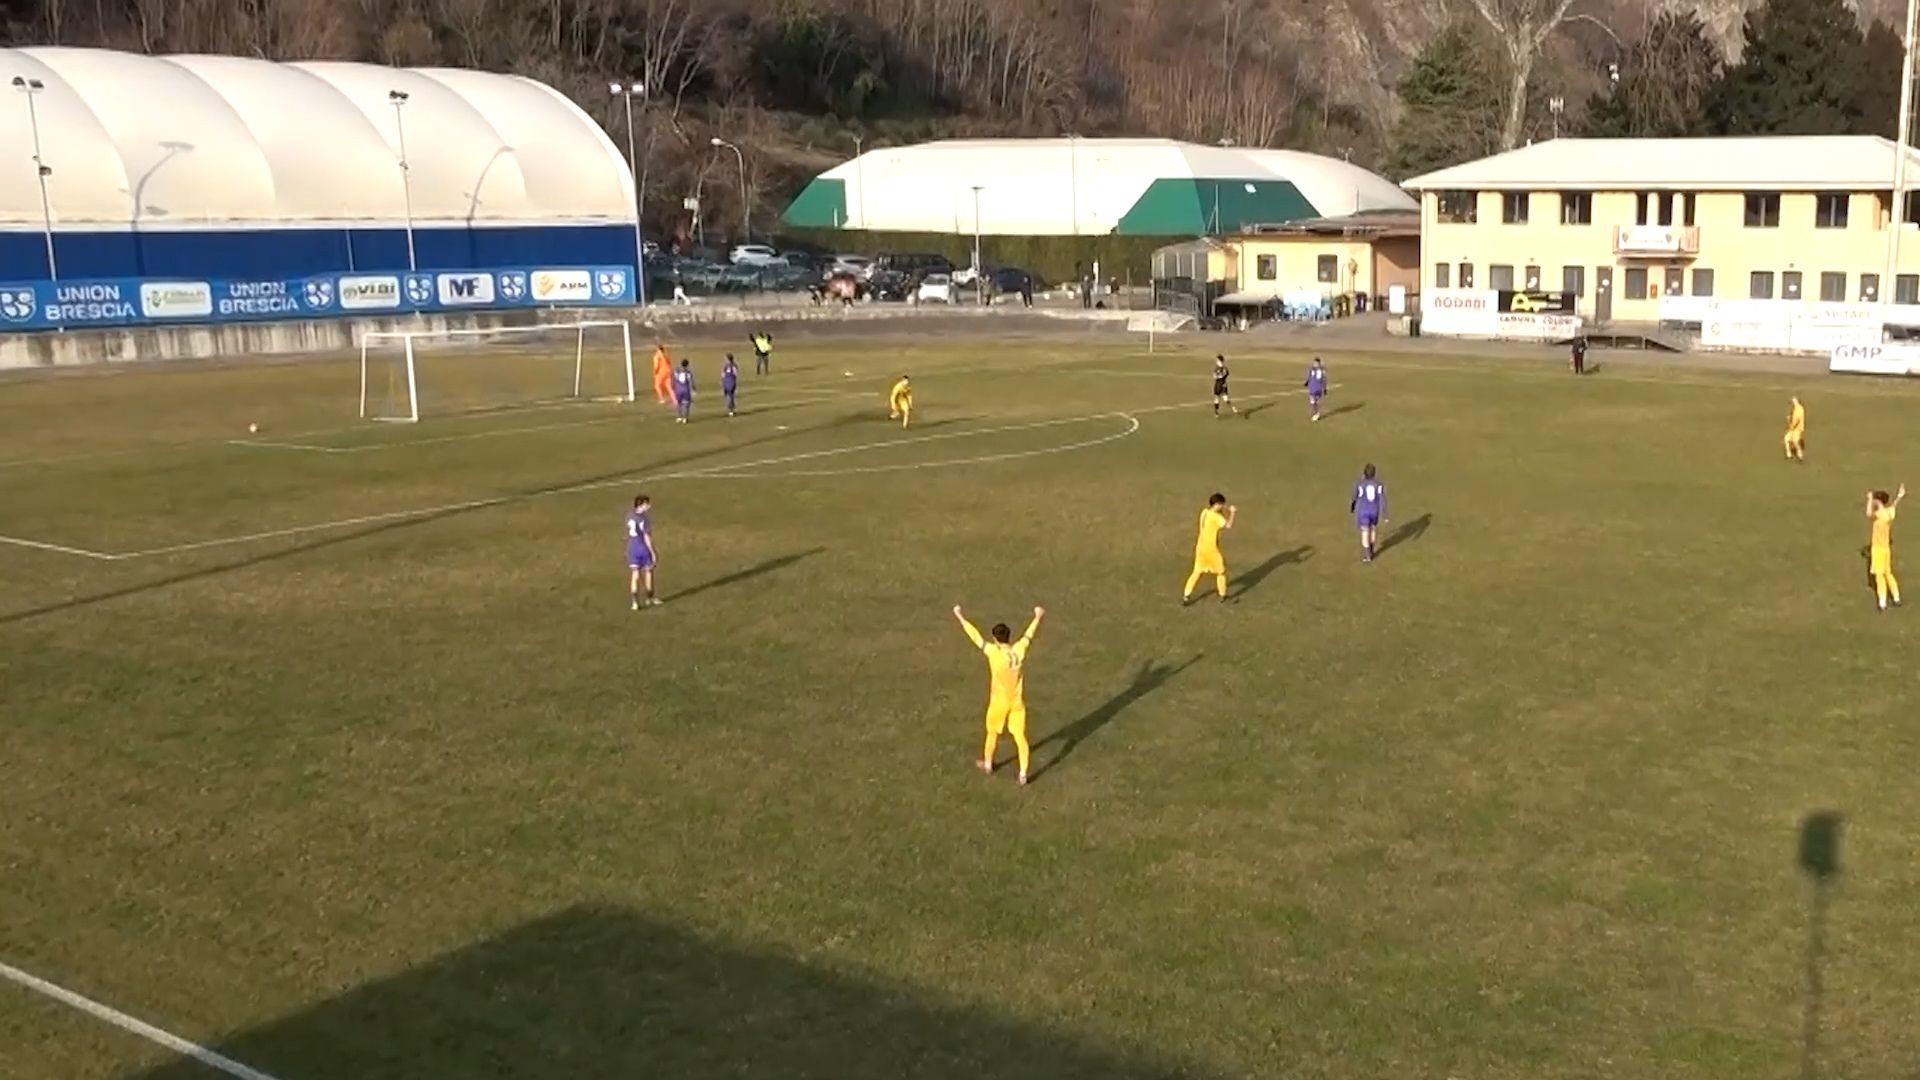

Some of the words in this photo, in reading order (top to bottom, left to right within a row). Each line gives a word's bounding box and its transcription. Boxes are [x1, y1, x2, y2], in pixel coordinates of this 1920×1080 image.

[57, 284, 120, 301] UNION
[230, 281, 286, 297] UNION
[45, 301, 137, 320] BRESCIA
[219, 295, 300, 314] BRESCIA
